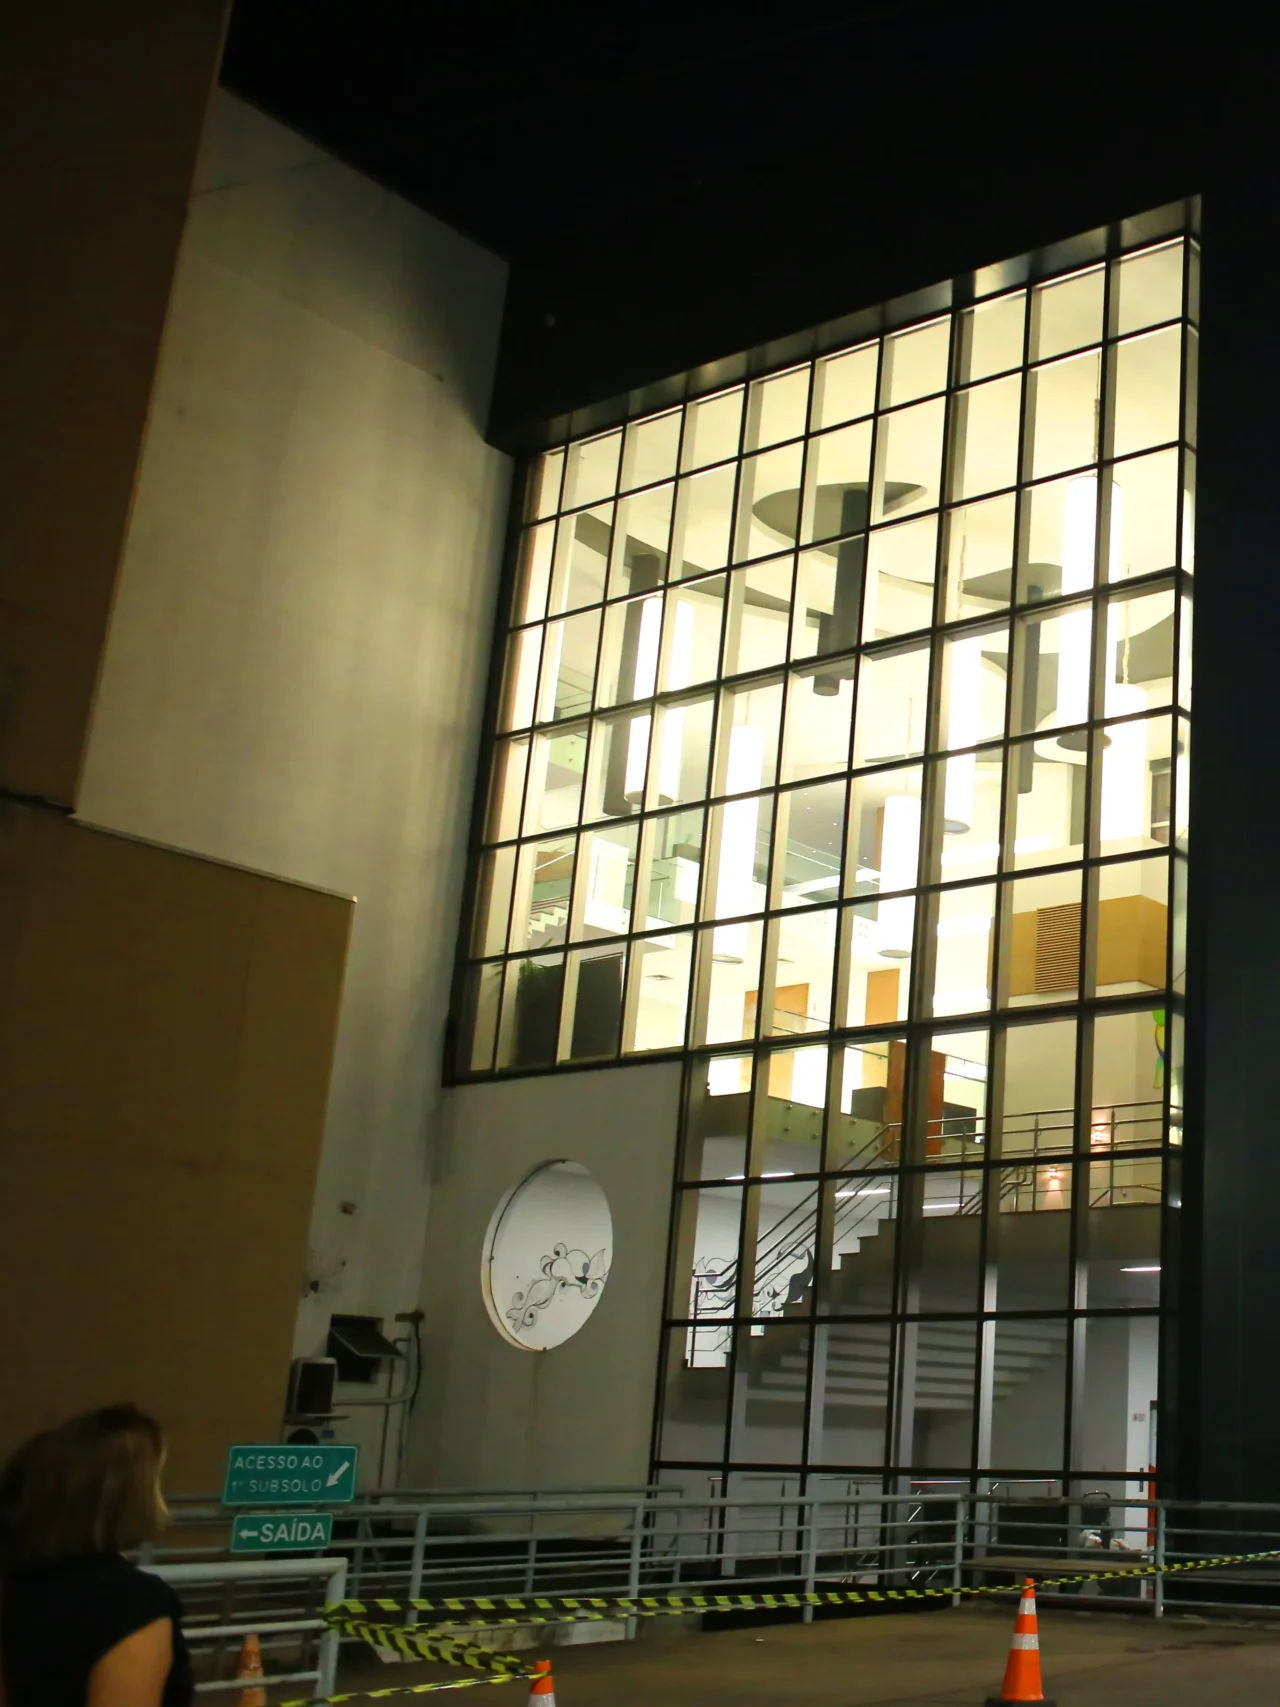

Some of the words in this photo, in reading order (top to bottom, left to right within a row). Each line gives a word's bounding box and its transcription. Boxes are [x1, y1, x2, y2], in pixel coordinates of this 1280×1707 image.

[234, 1456, 297, 1469] ACESSO
[301, 1456, 323, 1469] AO
[249, 1480, 322, 1492] SUBSOLO
[260, 1518, 325, 1543] SAÍDA
